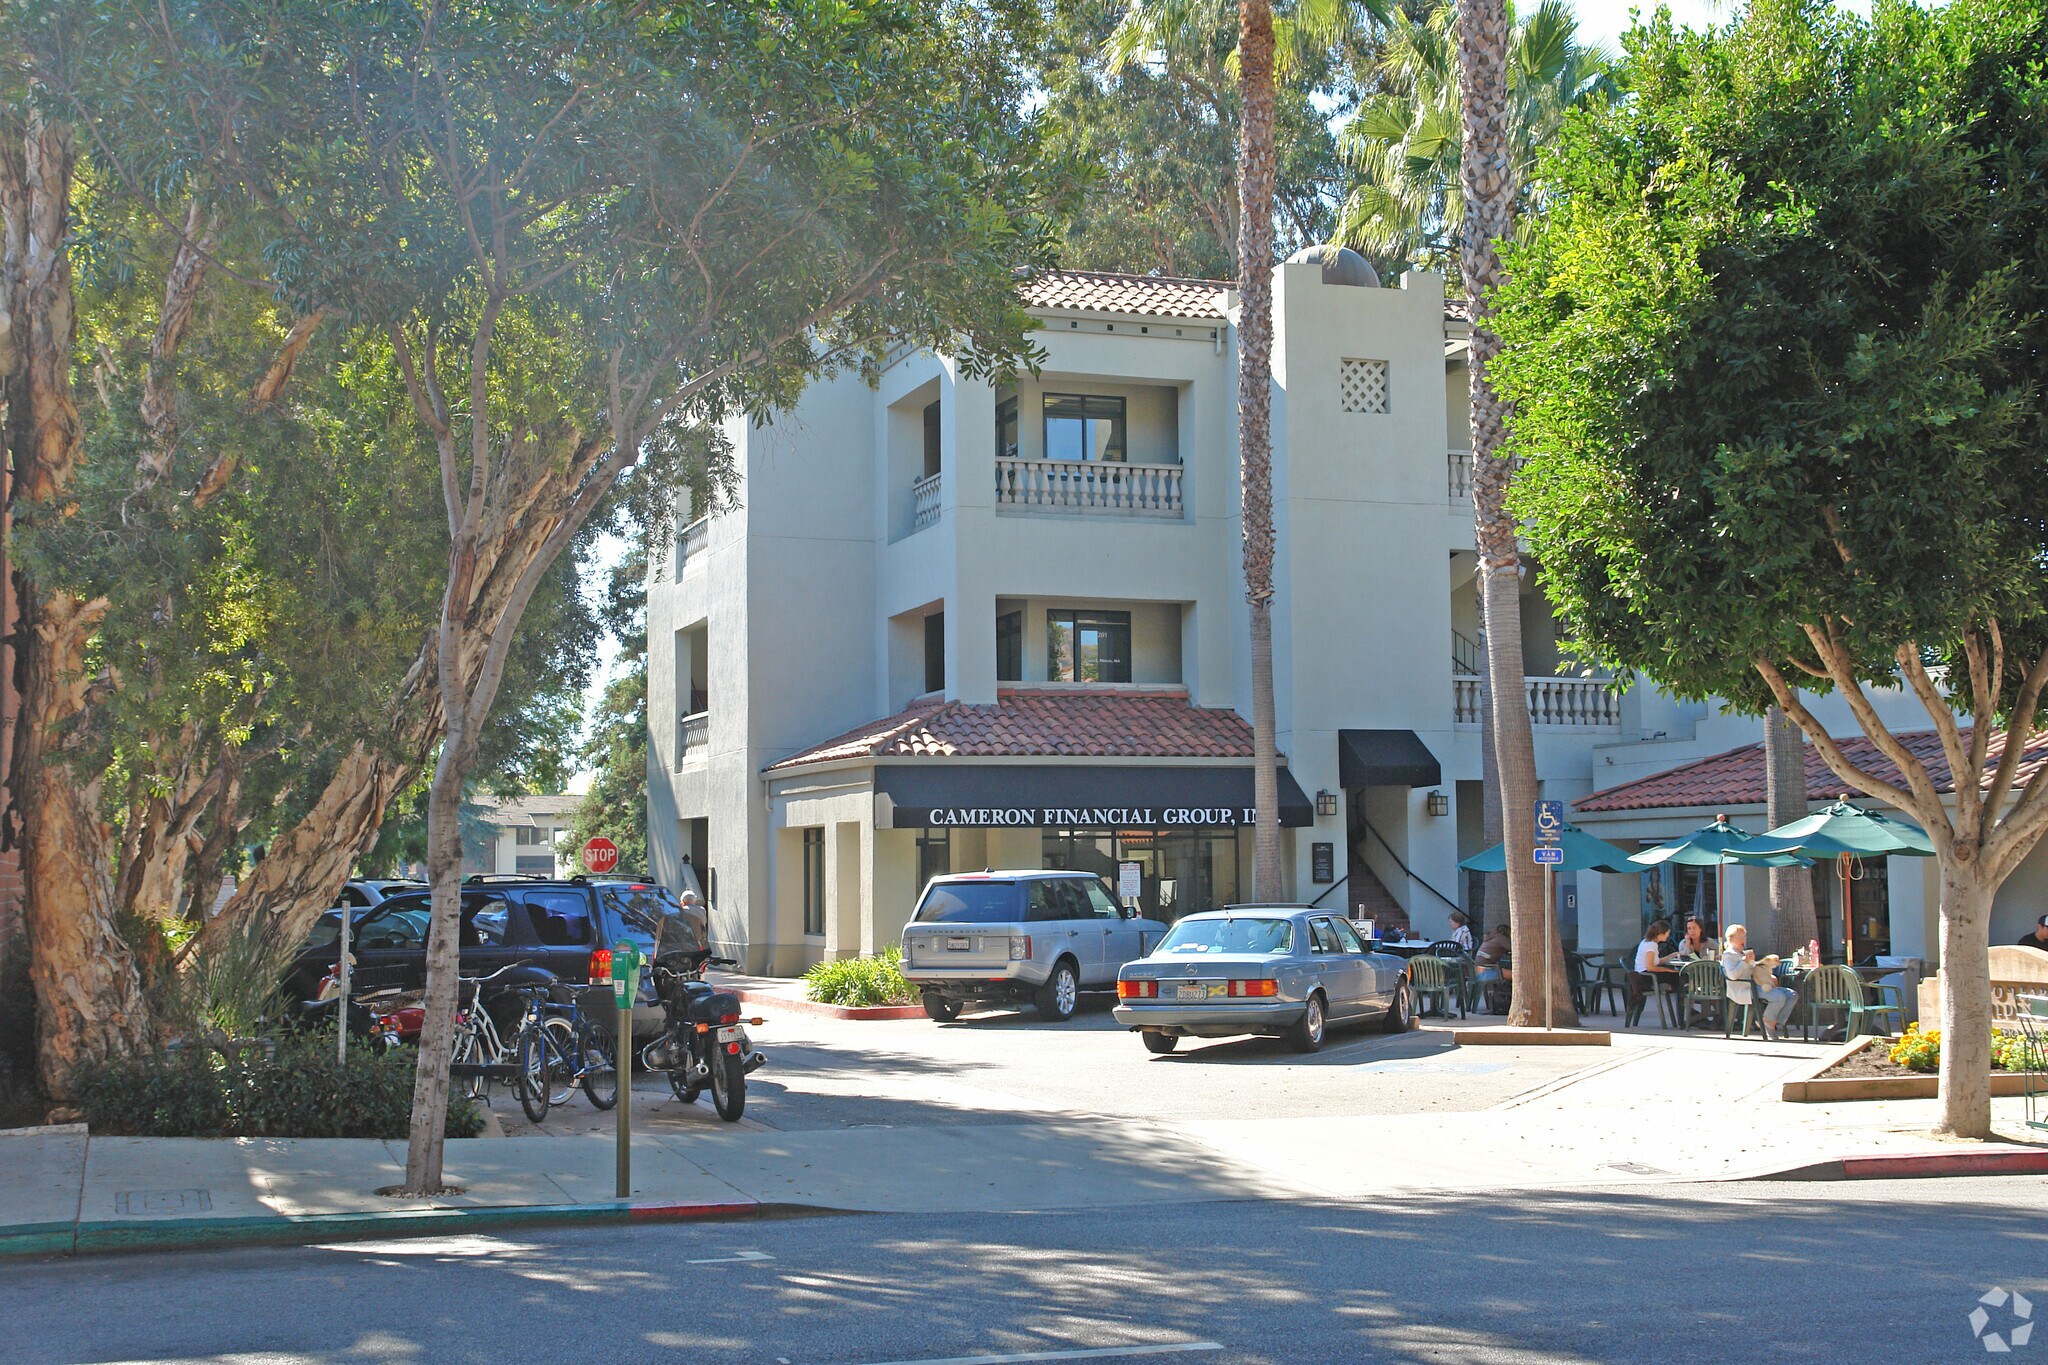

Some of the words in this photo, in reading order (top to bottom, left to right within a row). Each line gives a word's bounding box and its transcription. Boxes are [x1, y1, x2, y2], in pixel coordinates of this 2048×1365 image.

[929, 808, 1036, 825] CAMERON
[1043, 808, 1157, 825] FINANCIAL
[1162, 808, 1236, 826] GROUP,
[585, 848, 616, 862] STOP
